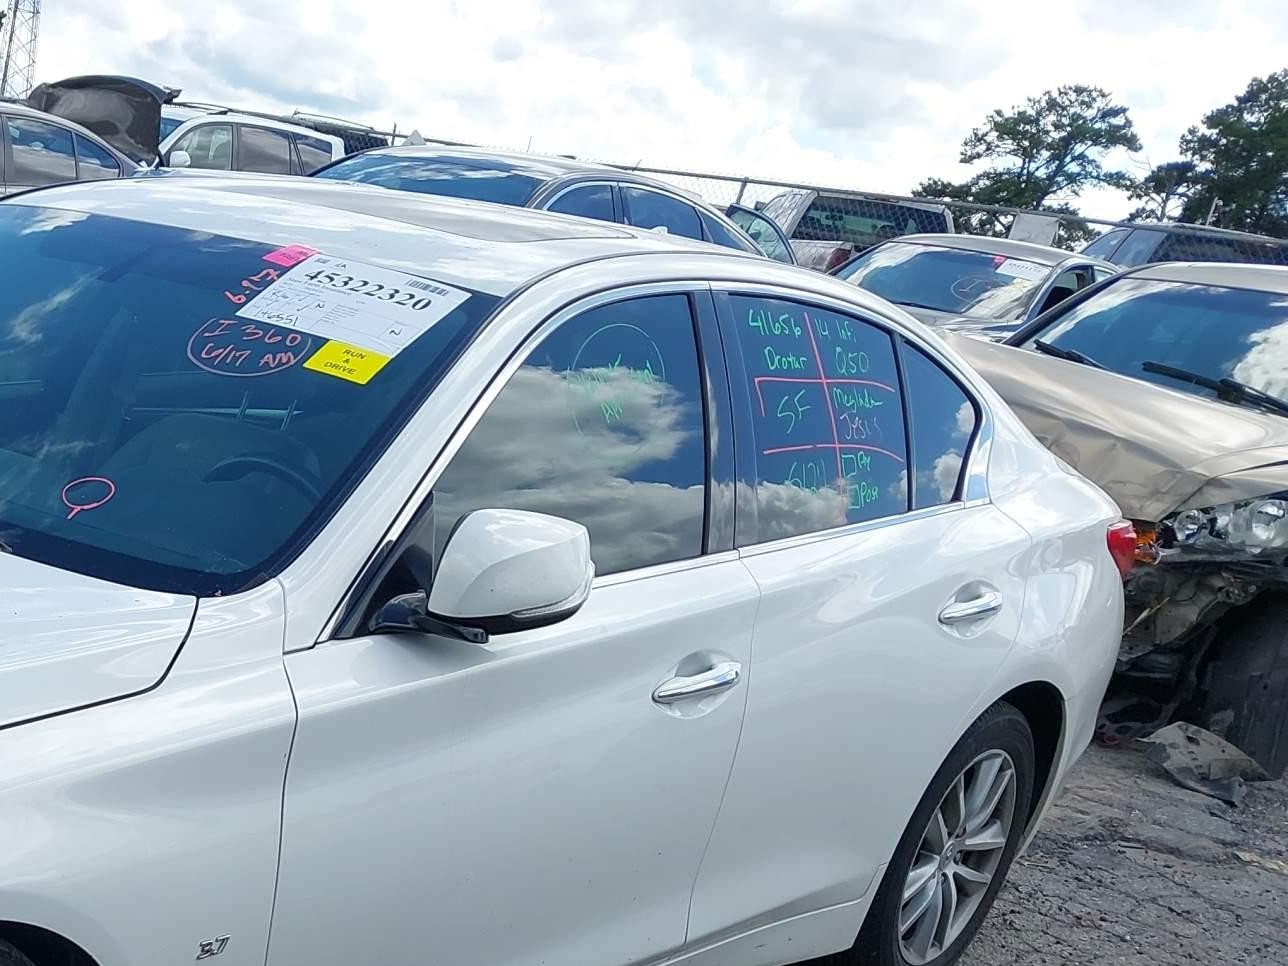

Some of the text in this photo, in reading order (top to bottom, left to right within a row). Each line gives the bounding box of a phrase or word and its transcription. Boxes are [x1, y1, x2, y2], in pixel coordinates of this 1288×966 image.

[304, 270, 432, 311] 45322320
[201, 343, 294, 368] 6/17 AM
[343, 349, 367, 360] RUN
[835, 346, 870, 376] Q50
[323, 361, 357, 375] DRIVE
